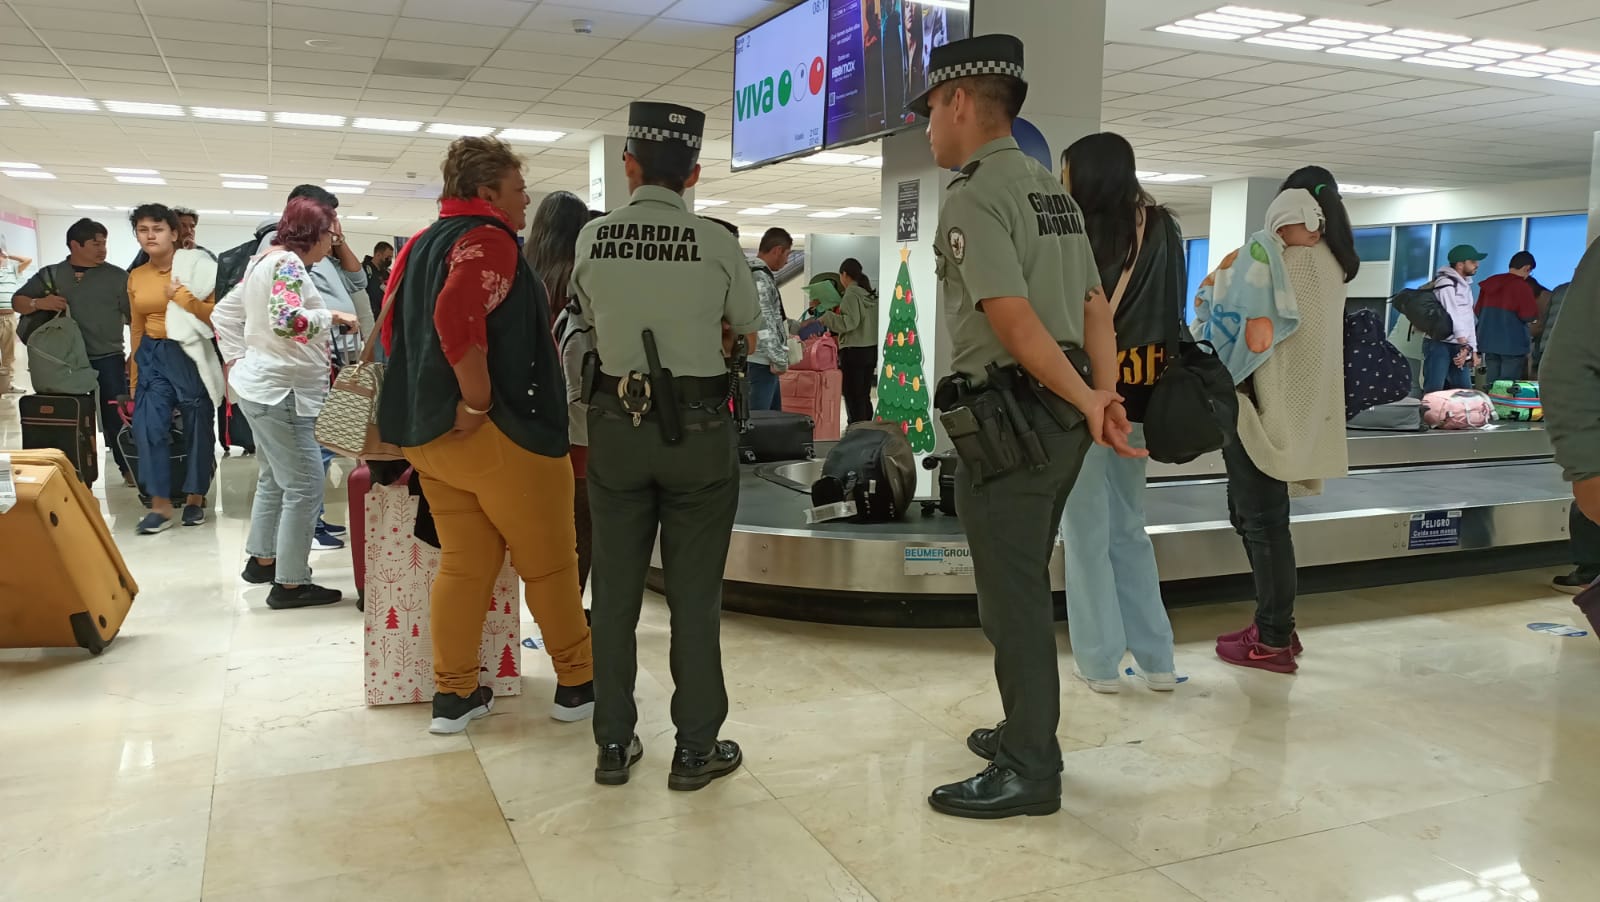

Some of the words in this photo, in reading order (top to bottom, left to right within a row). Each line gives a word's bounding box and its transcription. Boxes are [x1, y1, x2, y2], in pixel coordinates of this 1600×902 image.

[668, 113, 687, 125] GN
[596, 223, 697, 243] GUARDIA
[1037, 214, 1083, 236] NAONAL
[589, 242, 701, 262] NACIONAL
[1421, 518, 1450, 529] PELIGRO
